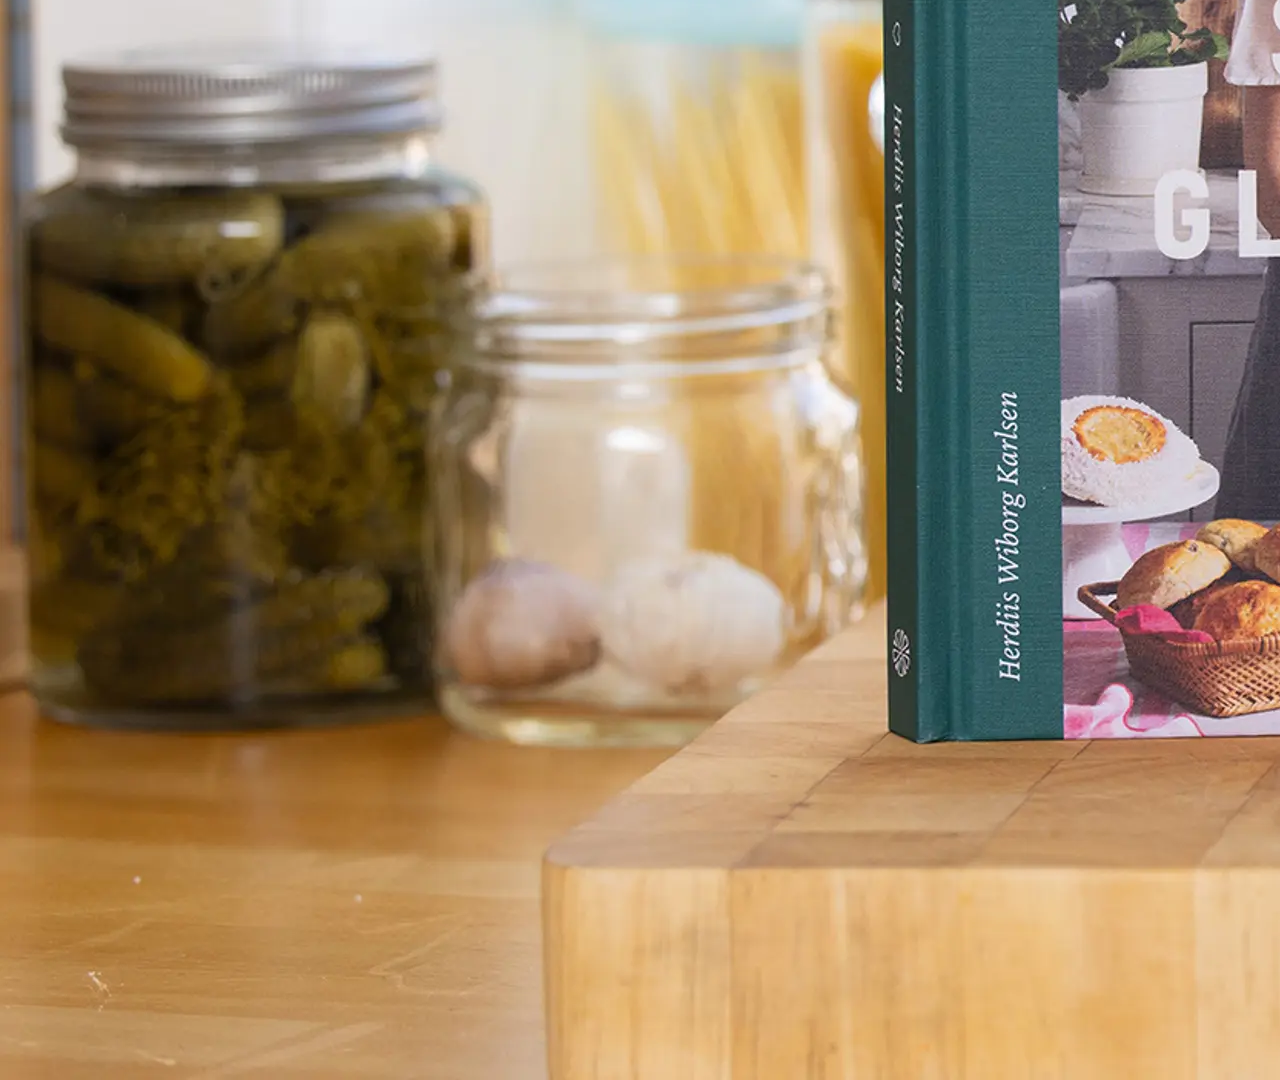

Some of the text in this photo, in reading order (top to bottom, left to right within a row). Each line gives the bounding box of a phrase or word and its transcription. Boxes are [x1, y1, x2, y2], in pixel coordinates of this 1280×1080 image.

[892, 103, 905, 394] Herdiis Wiborg Karlsen
[993, 391, 1026, 682] Herdiis Wiborg Karlsen
